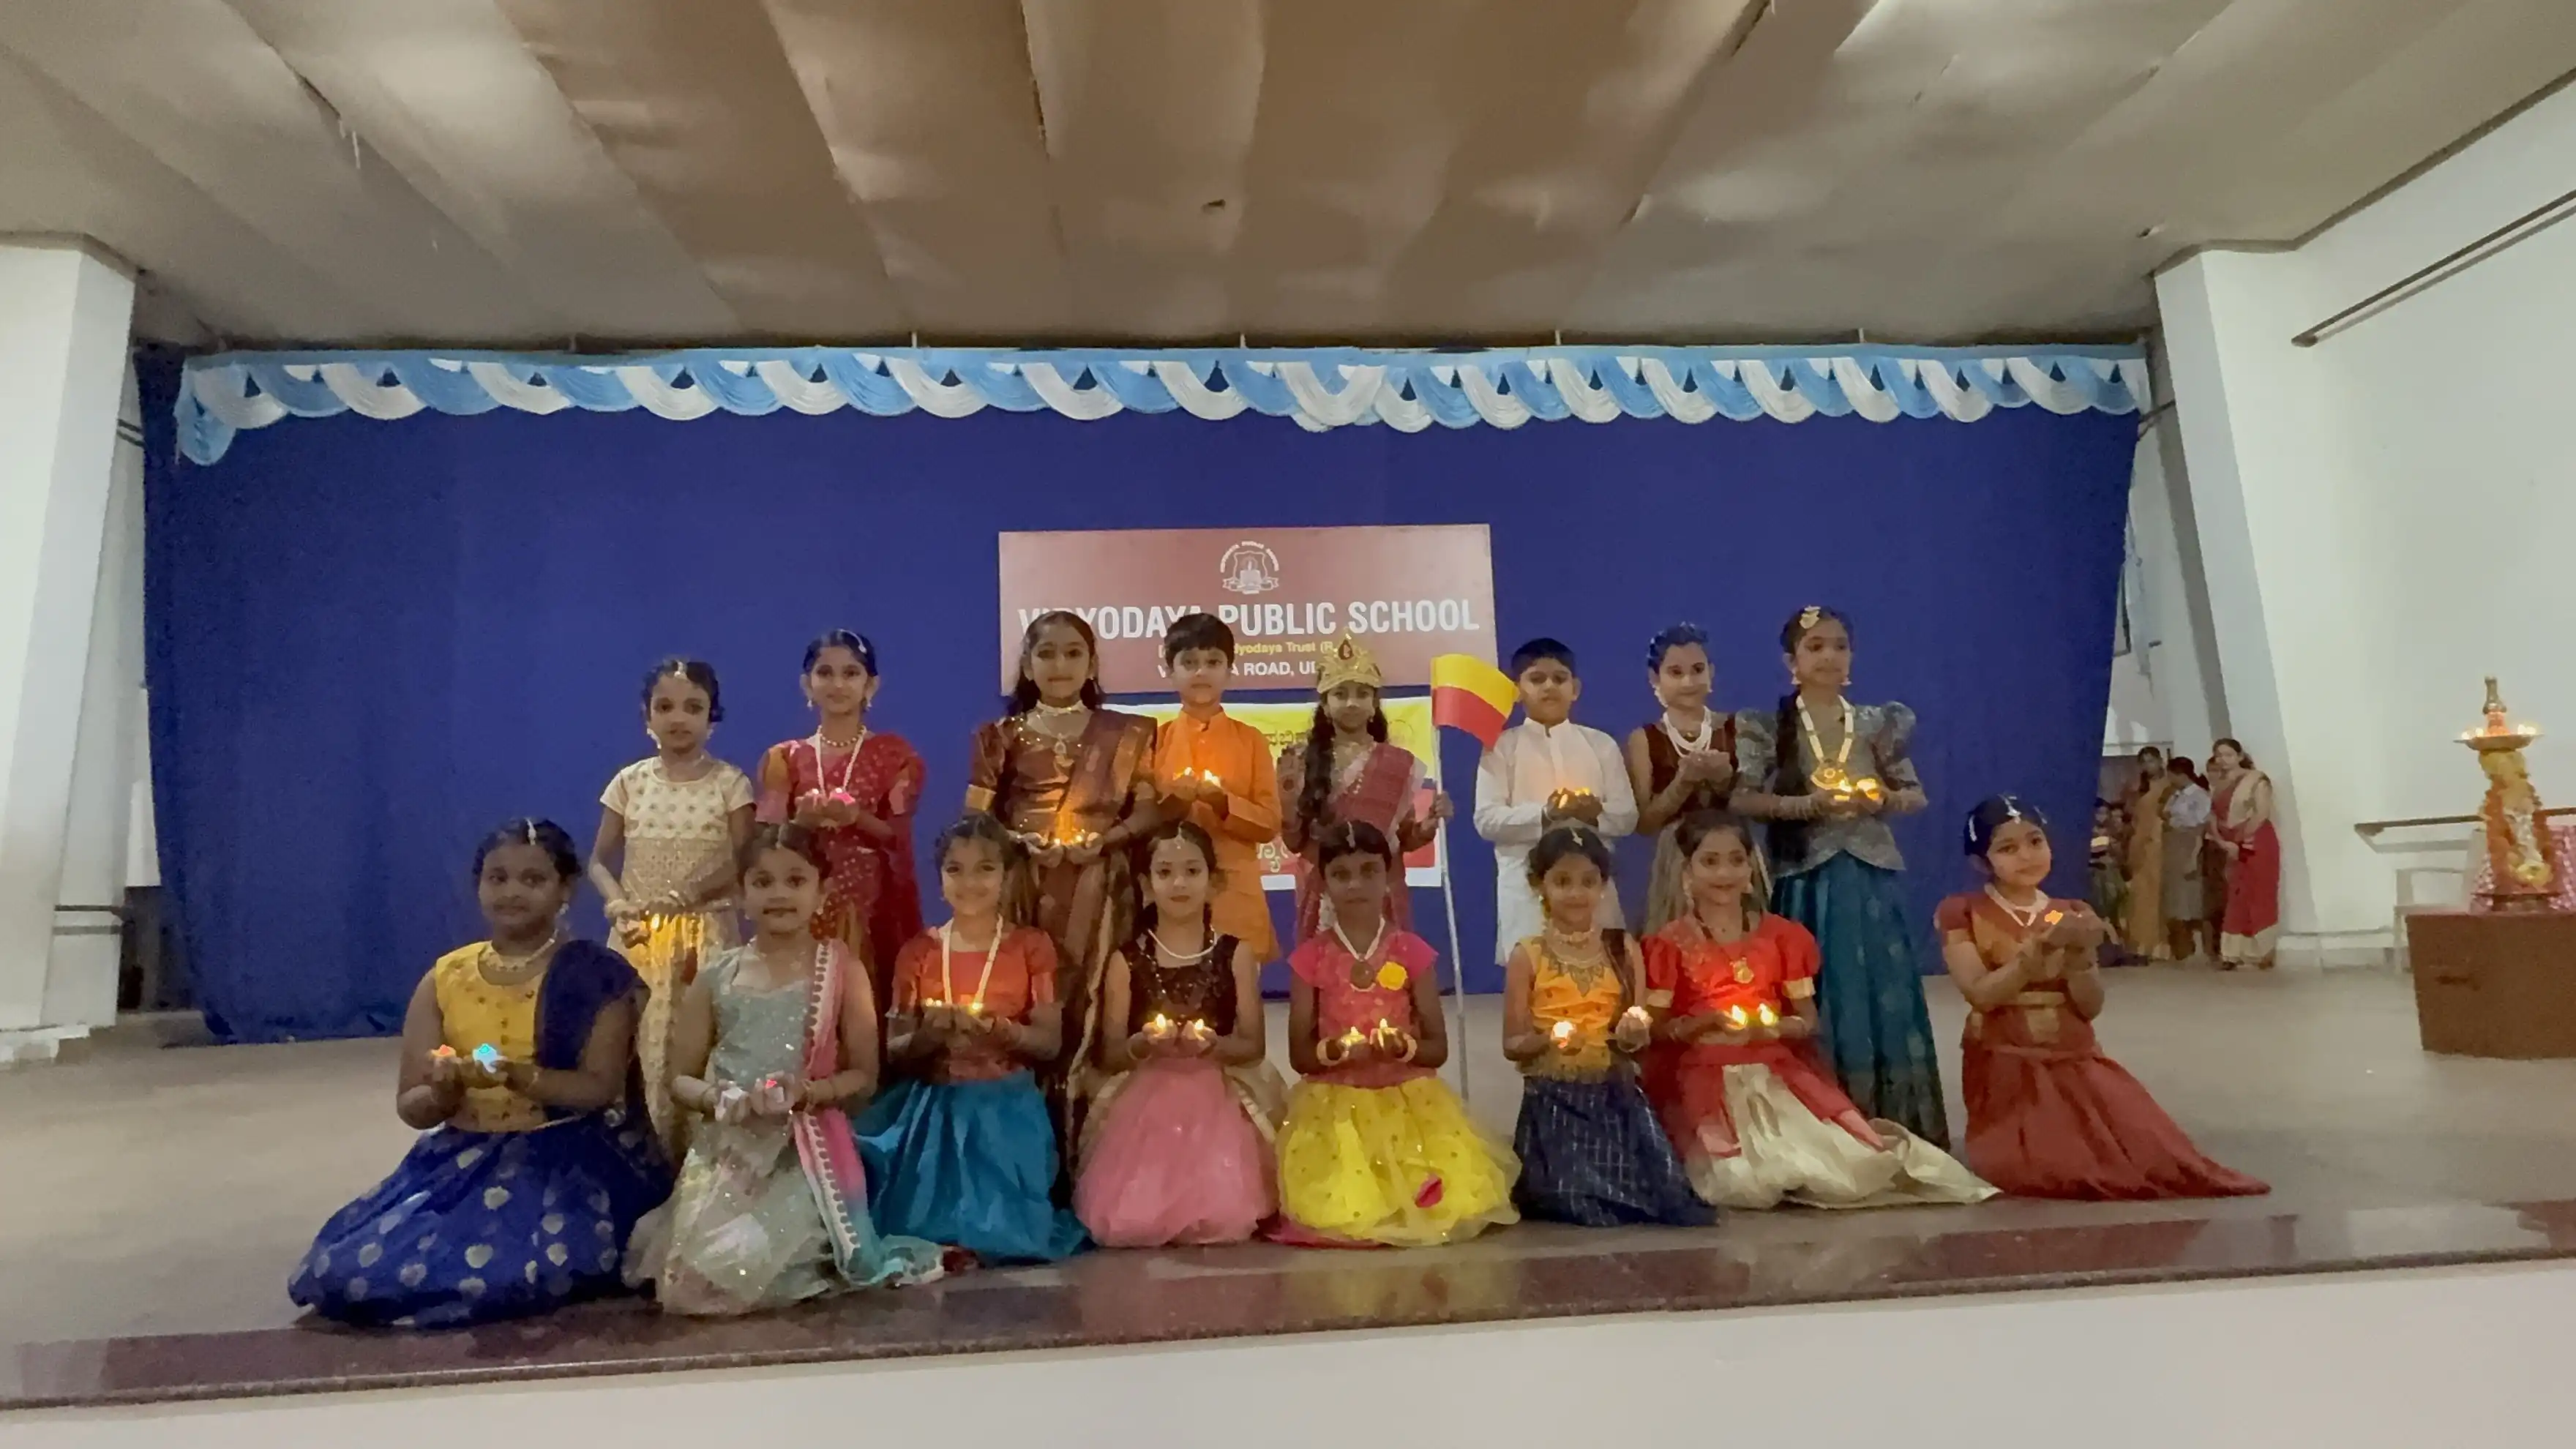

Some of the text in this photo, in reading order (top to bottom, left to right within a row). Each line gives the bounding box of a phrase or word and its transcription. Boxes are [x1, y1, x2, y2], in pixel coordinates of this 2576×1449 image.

[1016, 599, 1480, 640] VYODAY PUBLIC SCHOOL
[1286, 641, 1316, 653] Trust
[1243, 662, 1295, 676] ROAD,
